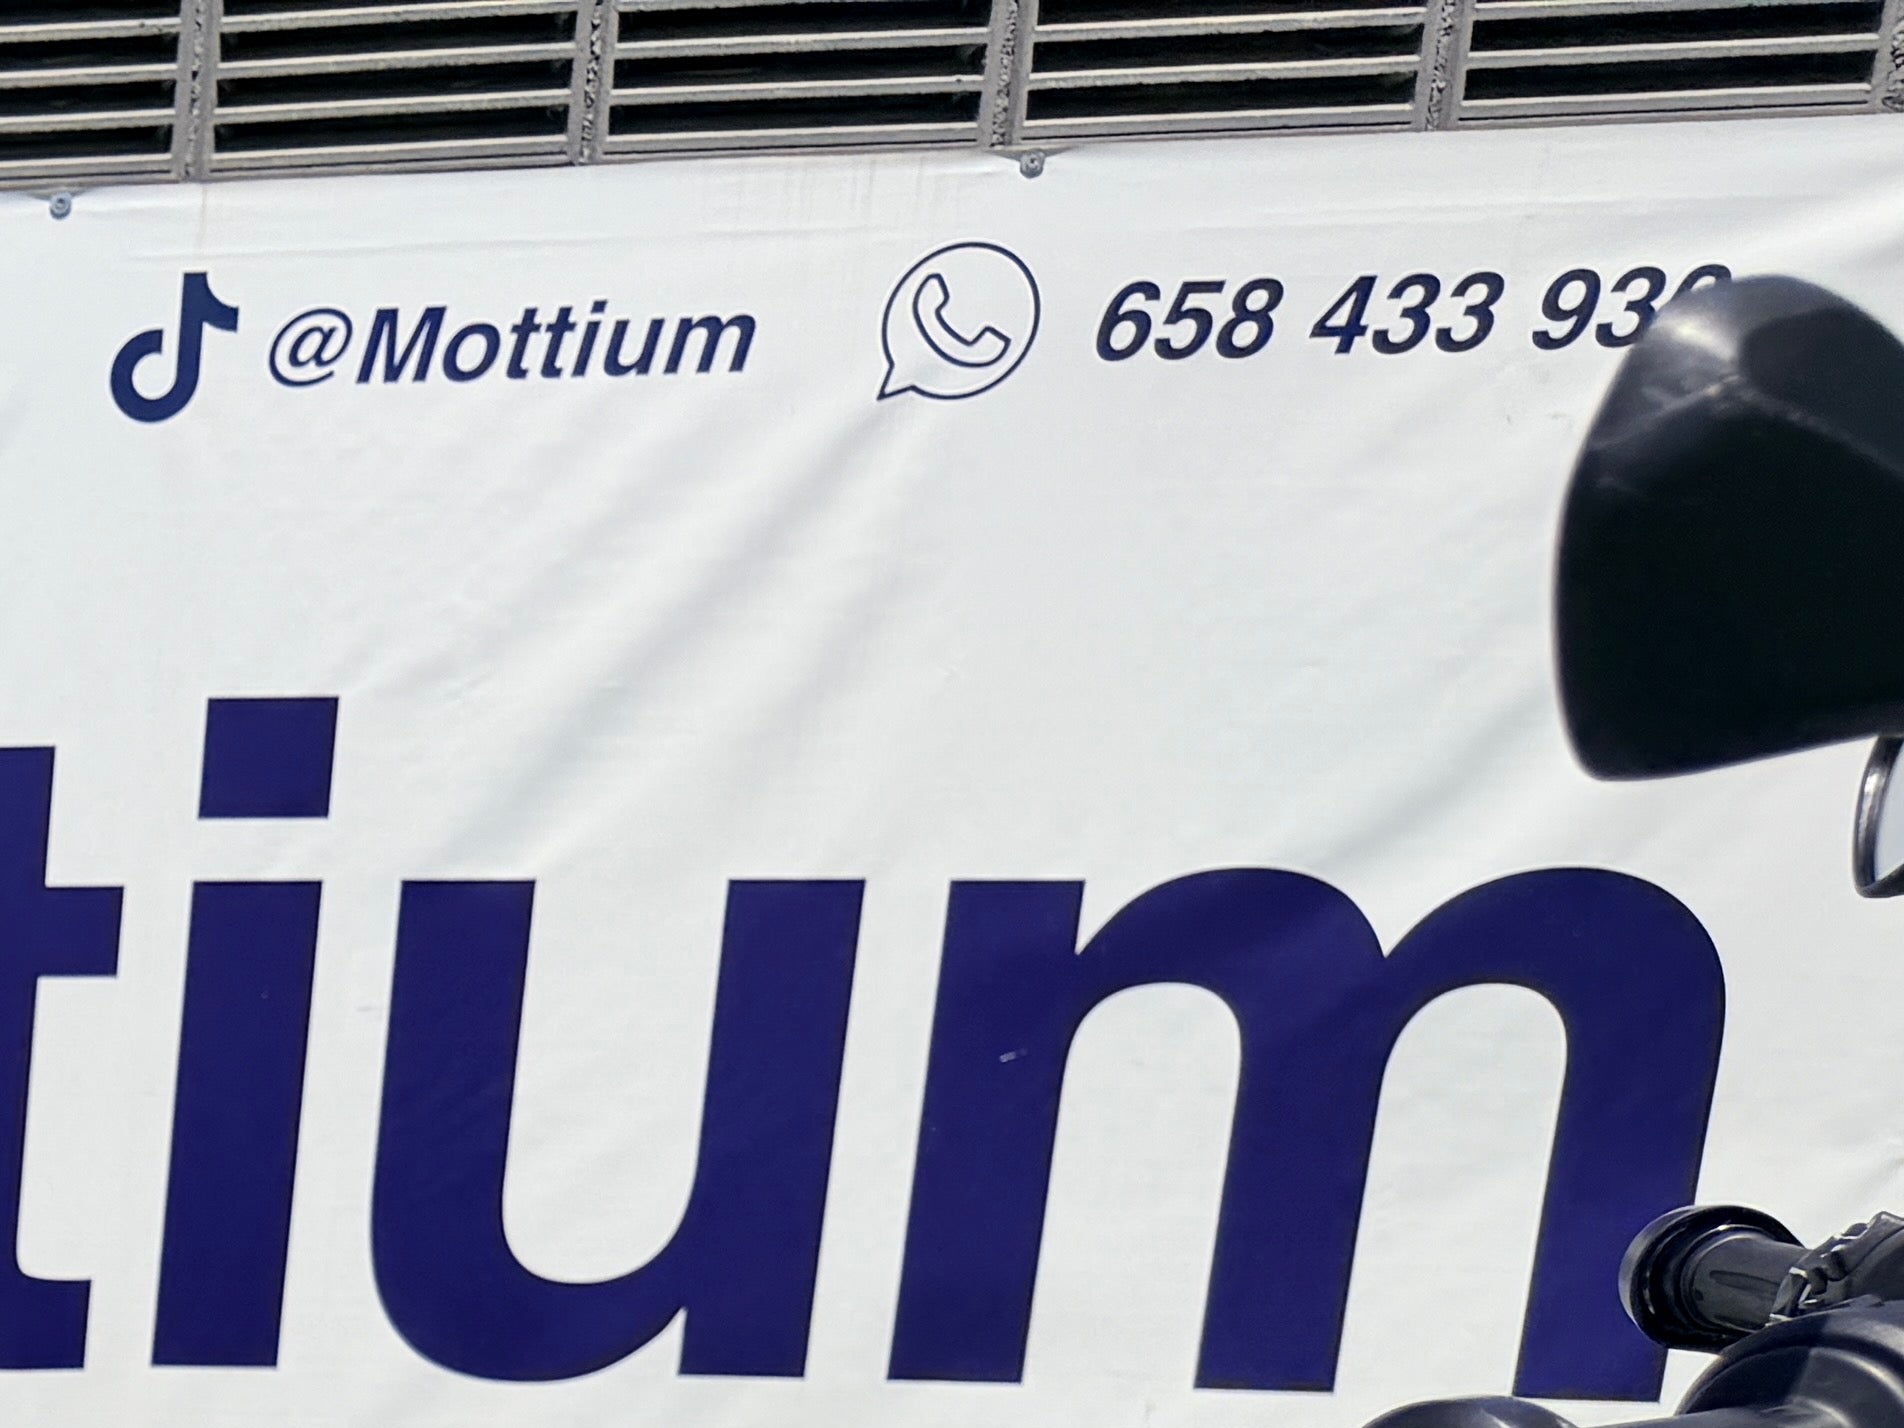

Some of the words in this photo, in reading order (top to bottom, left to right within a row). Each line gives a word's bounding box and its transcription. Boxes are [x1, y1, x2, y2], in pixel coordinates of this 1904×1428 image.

[268, 299, 756, 388] @Mottium
[1095, 277, 1276, 362] 658
[1309, 270, 1505, 355] 433
